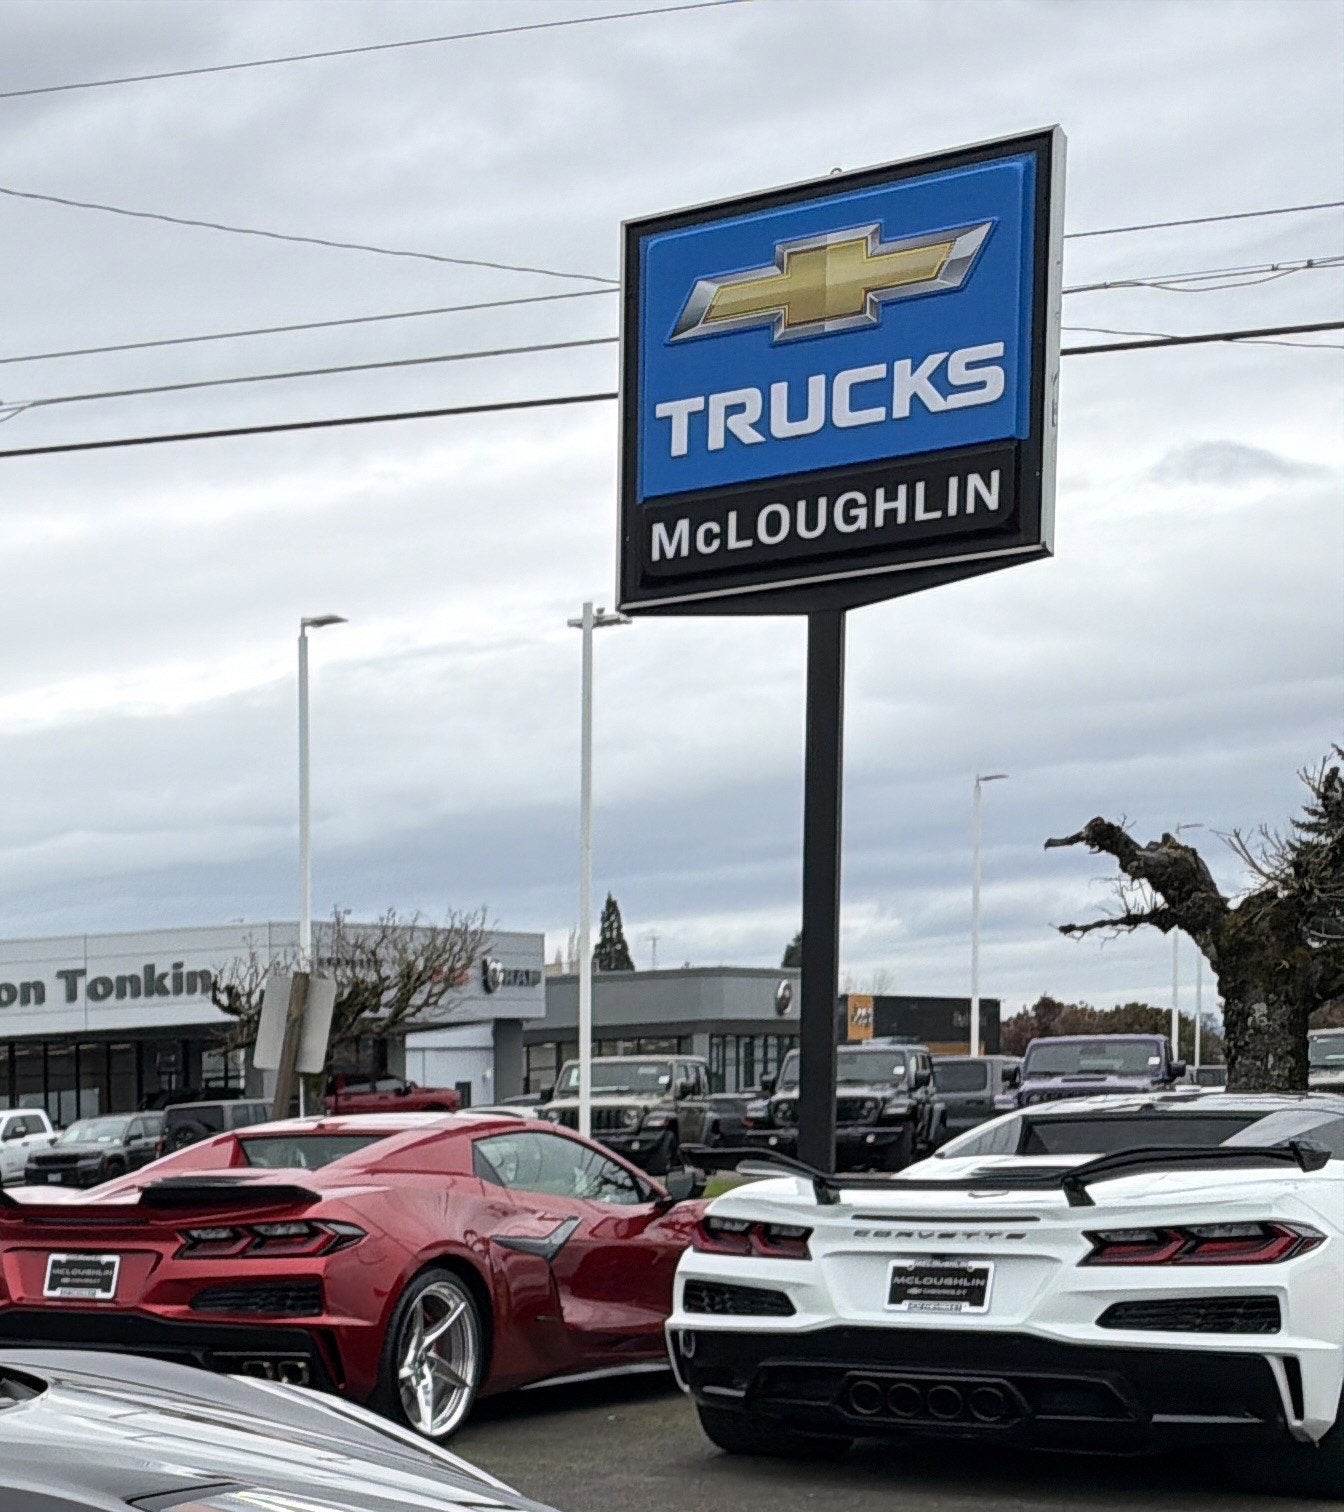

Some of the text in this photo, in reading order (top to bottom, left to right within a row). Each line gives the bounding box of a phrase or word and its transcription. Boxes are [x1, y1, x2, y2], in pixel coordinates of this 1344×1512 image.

[655, 341, 1005, 458] TRUCKS
[651, 469, 1001, 562] McLOUGHLIN
[55, 961, 213, 1004] Tonkin
[853, 1229, 1027, 1240] CORVETTE
